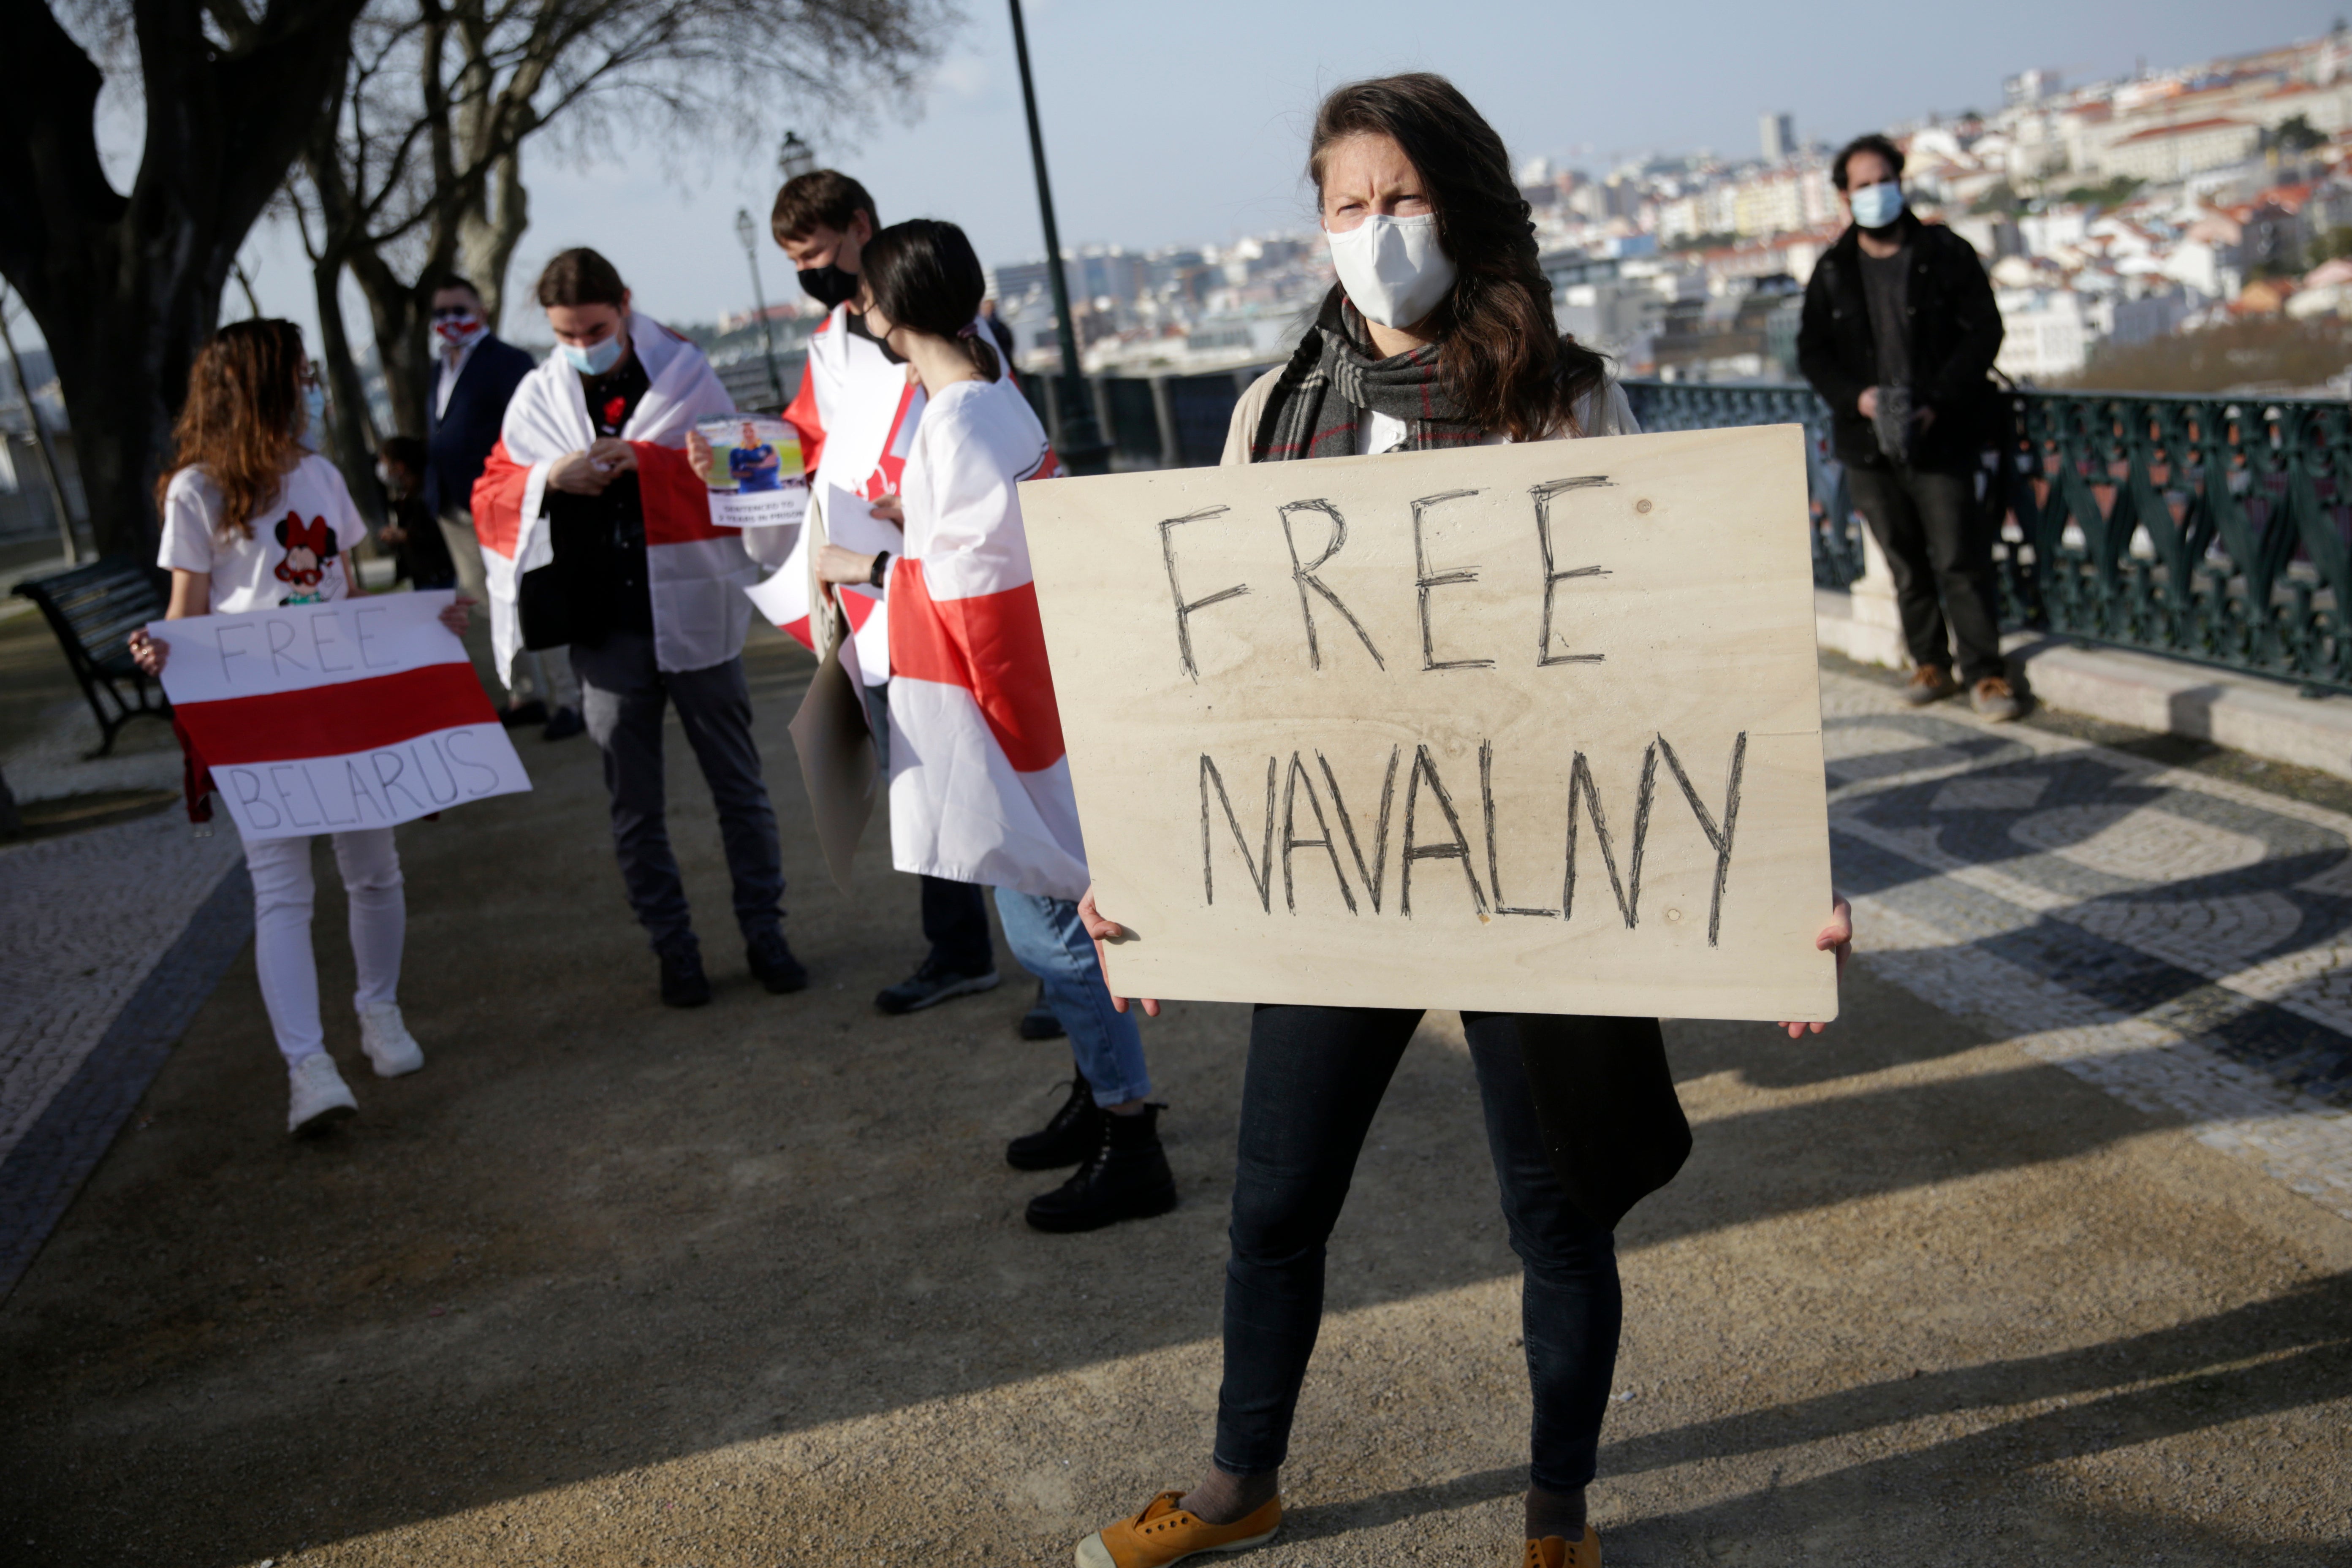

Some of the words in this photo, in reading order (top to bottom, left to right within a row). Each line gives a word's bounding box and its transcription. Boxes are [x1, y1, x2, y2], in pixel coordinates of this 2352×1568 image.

[723, 503, 779, 512] SENTENCED
[1158, 475, 1618, 685] FREE
[215, 606, 399, 683] FREE
[229, 730, 500, 830] BELARUS
[1198, 730, 1746, 949] NAVALNY
